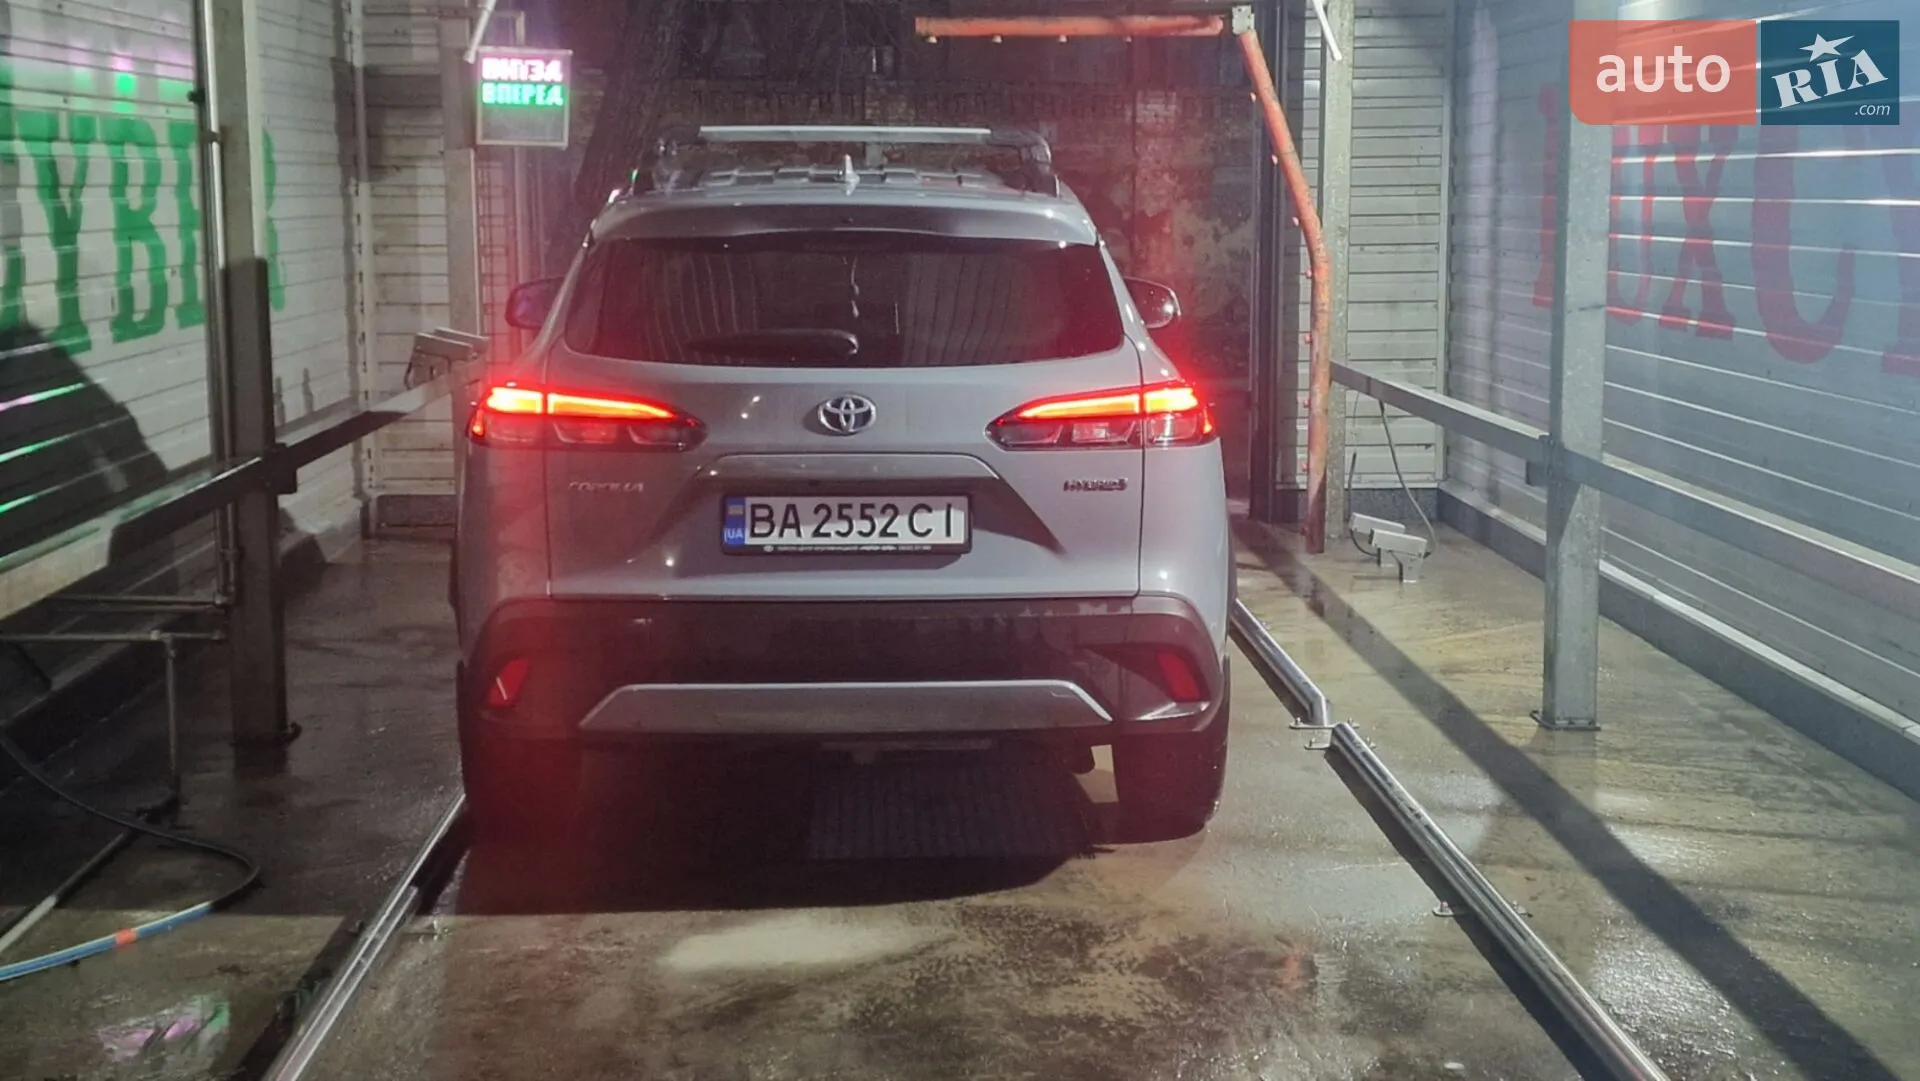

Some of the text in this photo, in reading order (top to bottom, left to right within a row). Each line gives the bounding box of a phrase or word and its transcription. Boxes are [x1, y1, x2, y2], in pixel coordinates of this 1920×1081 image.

[482, 82, 564, 106] ВПЕРЕД
[811, 503, 899, 538] 2552
[727, 528, 744, 540] UA
